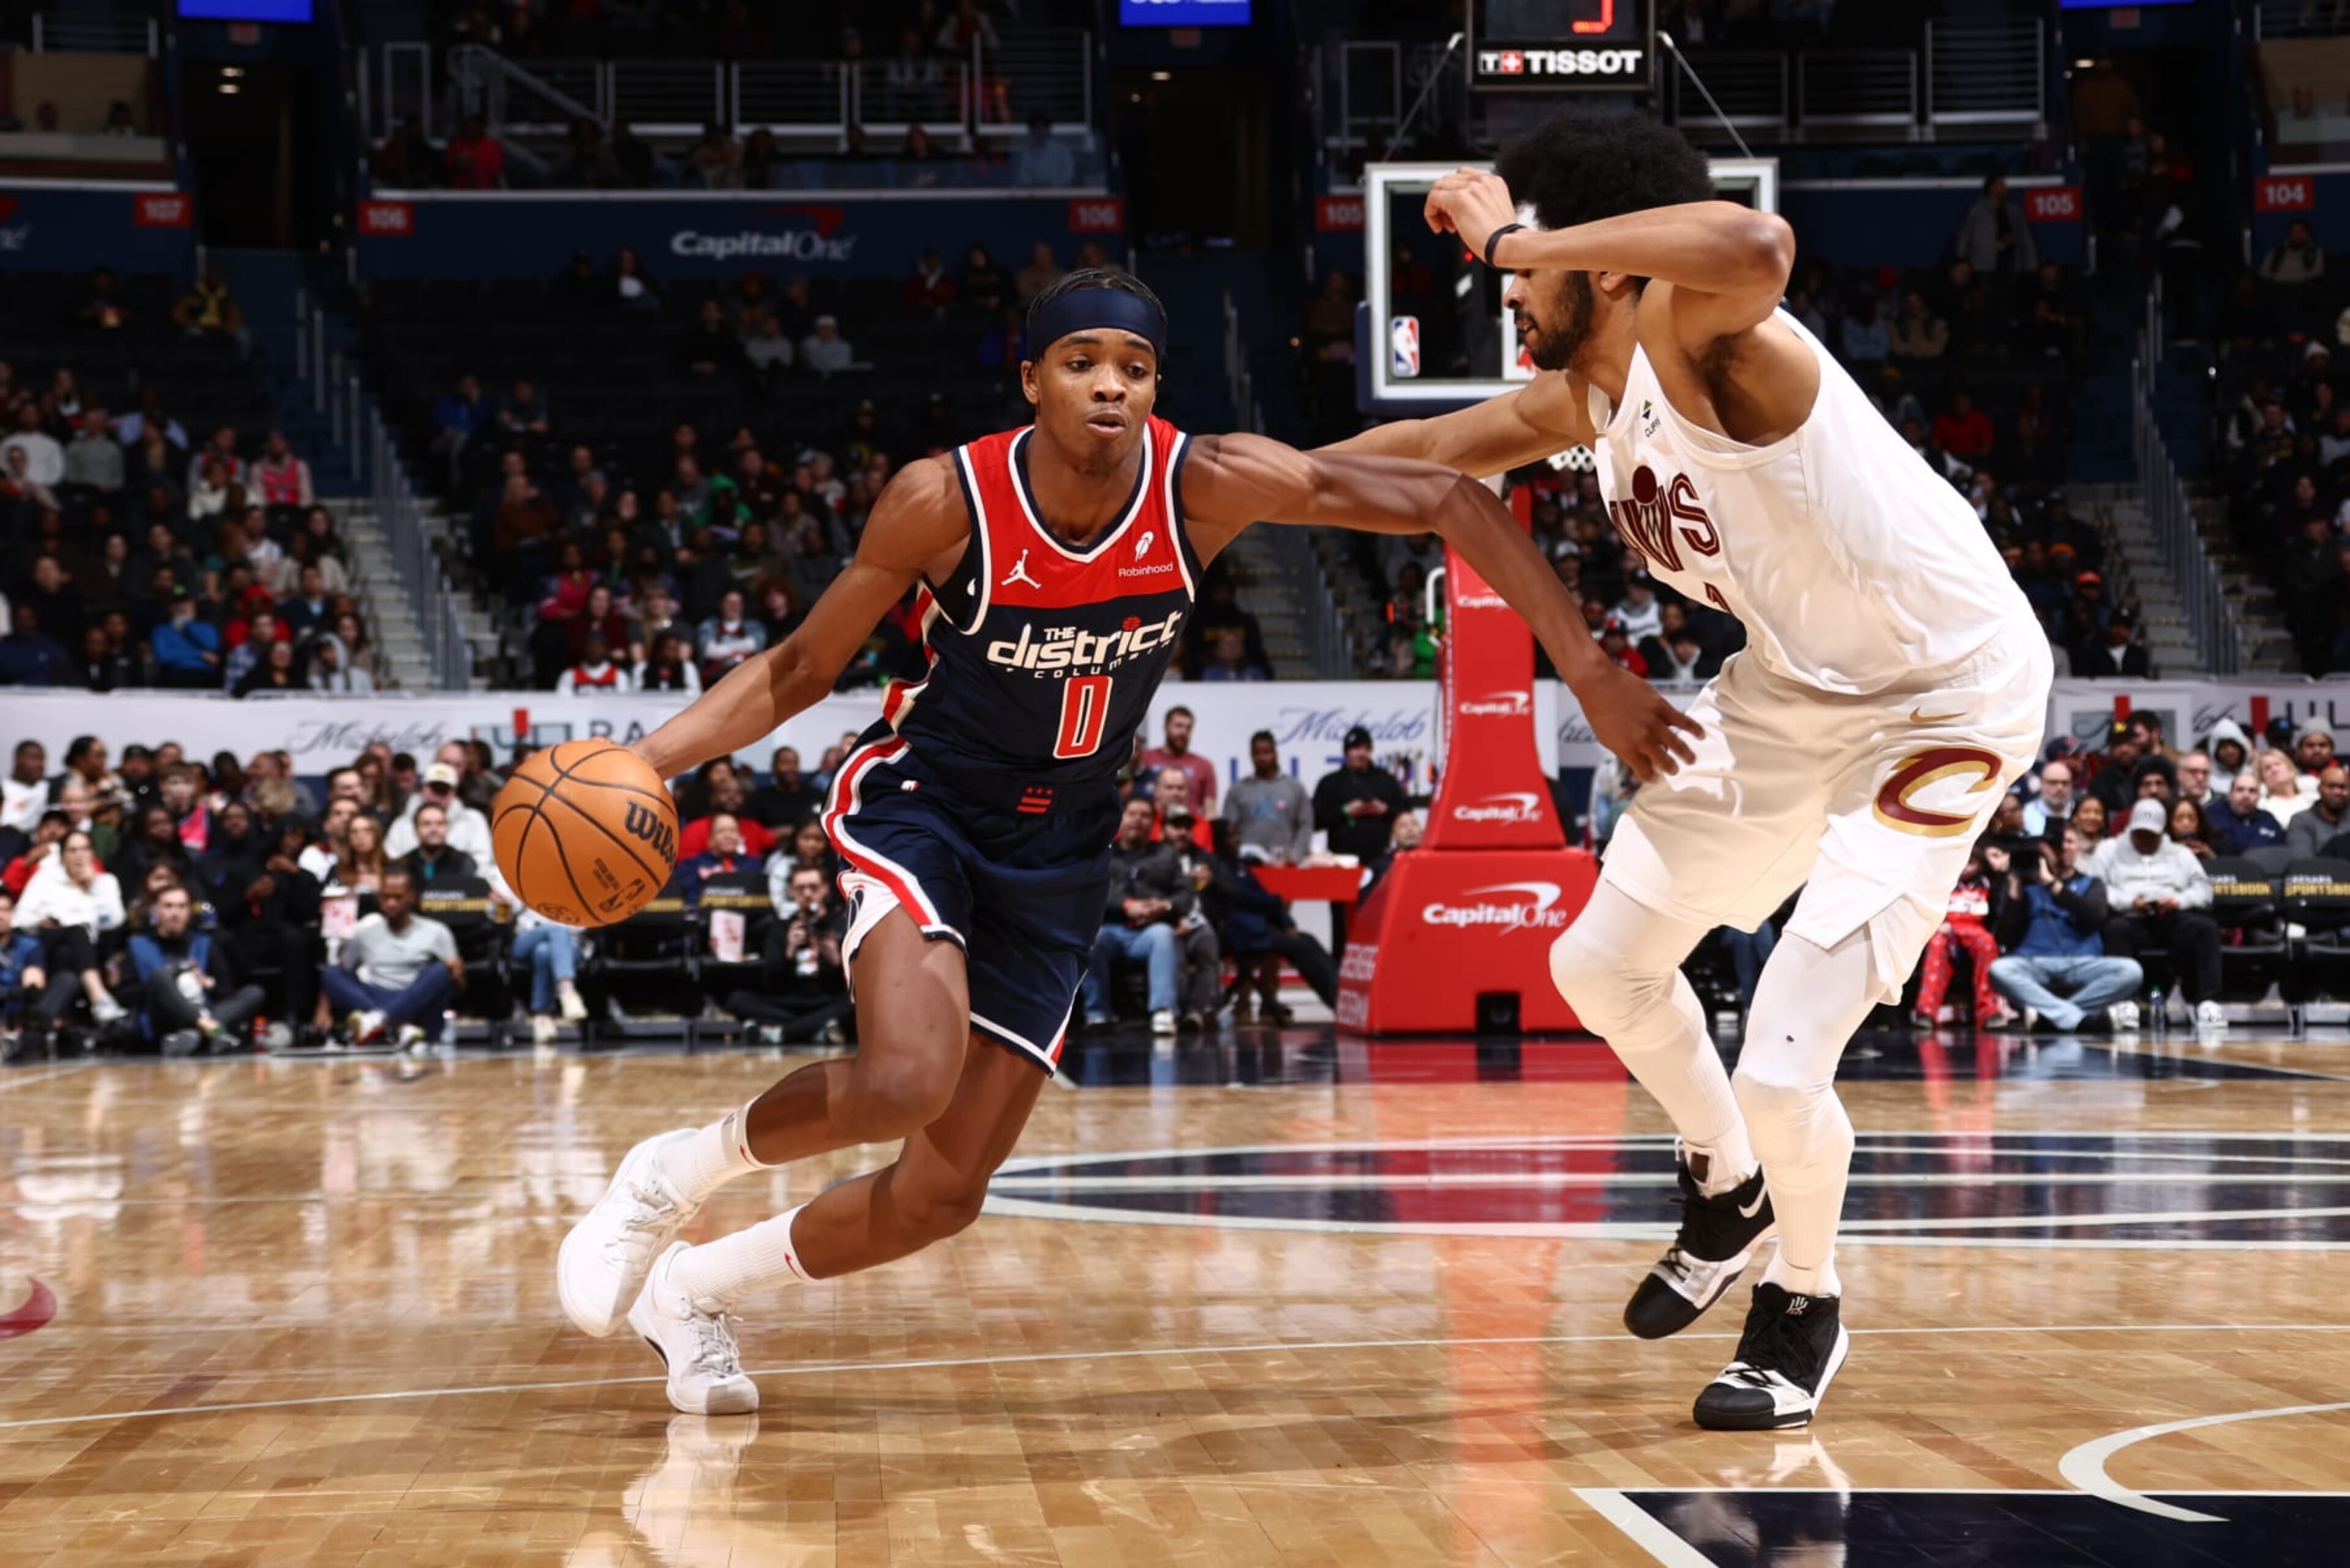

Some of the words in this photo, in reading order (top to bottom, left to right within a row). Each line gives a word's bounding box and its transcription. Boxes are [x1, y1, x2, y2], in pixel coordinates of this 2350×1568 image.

[1524, 50, 1643, 73] TISSOT
[2035, 194, 2075, 215] 105
[2265, 183, 2305, 205] 104
[1118, 561, 1174, 578] Robinhood
[1044, 625, 1076, 641] THE
[1053, 675, 1113, 759] 0
